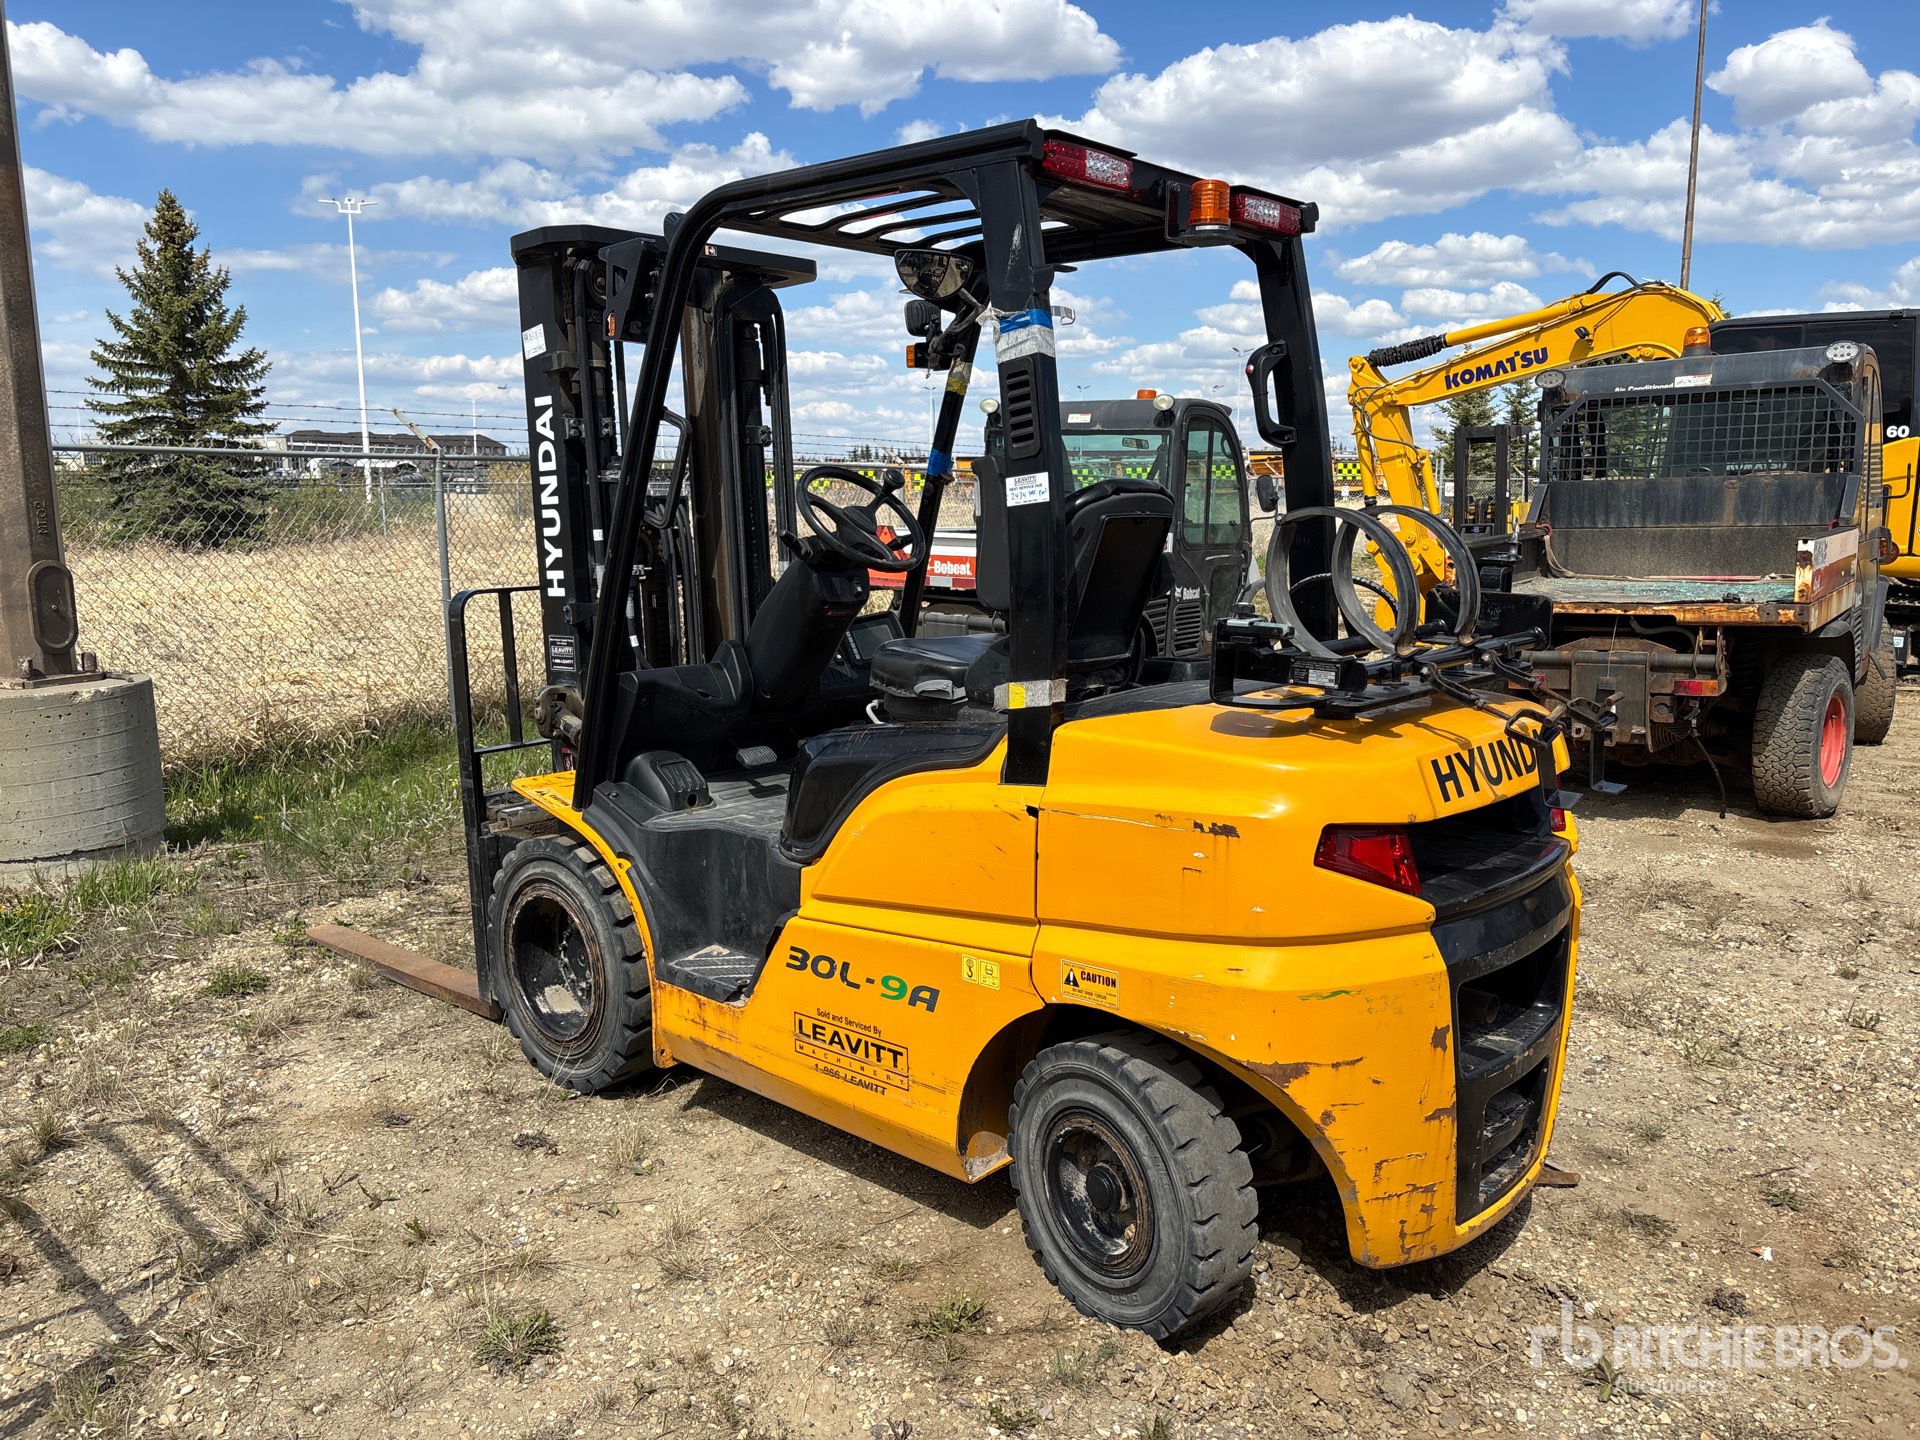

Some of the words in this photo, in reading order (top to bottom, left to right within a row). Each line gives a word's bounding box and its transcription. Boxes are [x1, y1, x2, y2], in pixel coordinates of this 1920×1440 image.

[1445, 347, 1549, 390] KOMATSU
[1886, 425, 1910, 438] 60
[534, 395, 566, 597] HYUNDAI
[934, 560, 972, 576] Bobcat
[1183, 587, 1200, 600] Bobcat
[786, 945, 940, 1013] 30L-9A
[1081, 970, 1116, 988] CAUTION
[817, 1008, 830, 1019] Sold
[832, 1014, 843, 1023] and
[844, 1017, 871, 1032] Serviced
[873, 1025, 882, 1037] By
[798, 1018, 904, 1069] LEAVITT
